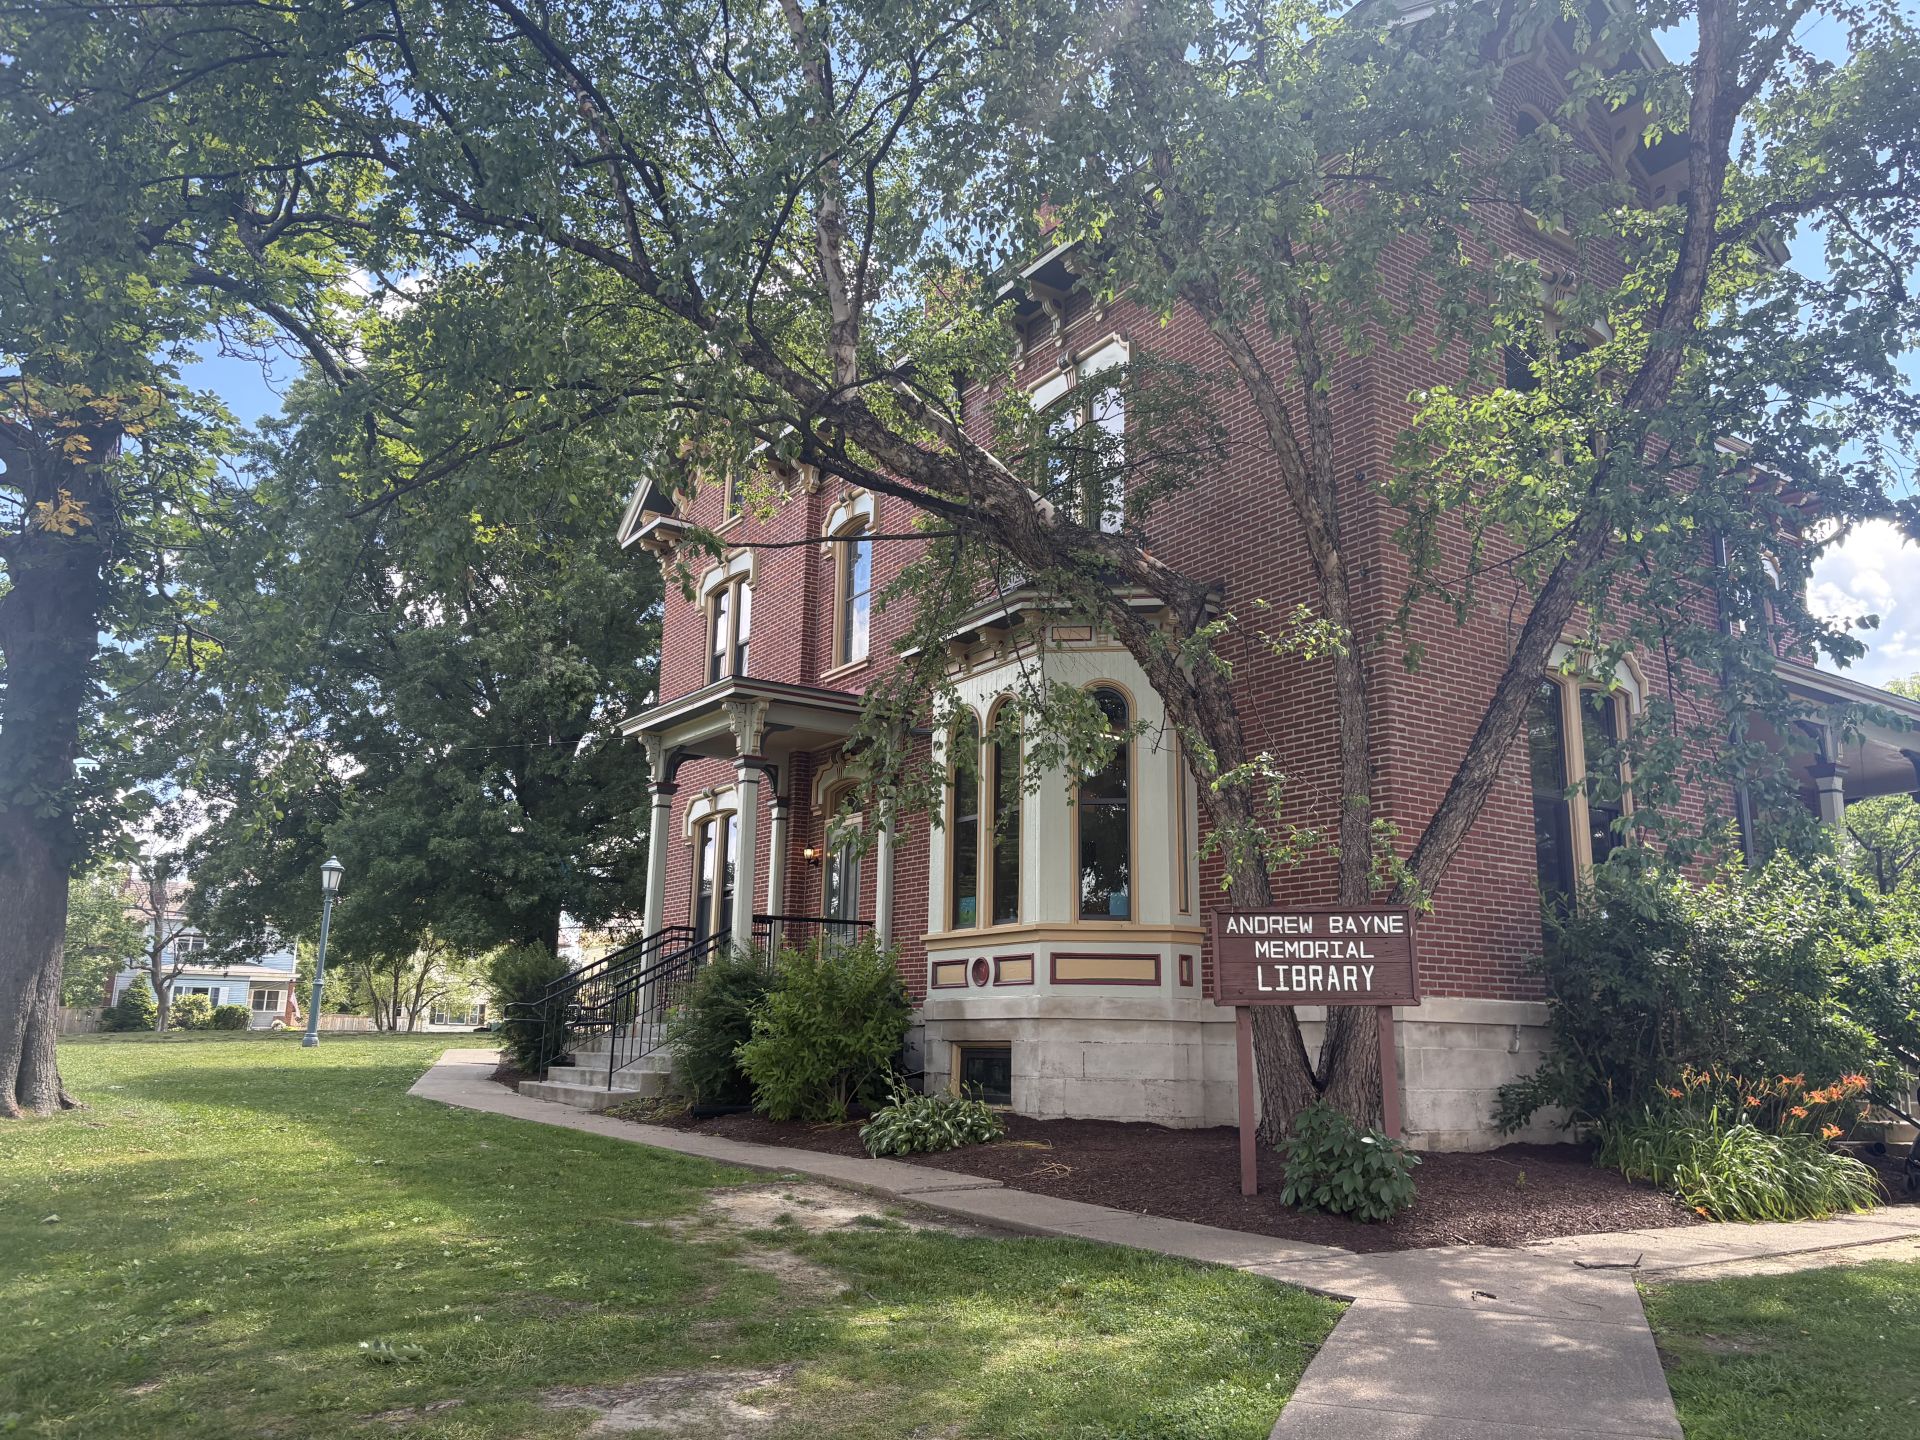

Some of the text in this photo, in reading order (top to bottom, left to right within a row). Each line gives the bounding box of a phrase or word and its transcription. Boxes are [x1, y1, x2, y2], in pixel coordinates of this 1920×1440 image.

[1227, 915, 1403, 934] ANDREW BAYNE
[1255, 941, 1375, 959] MEMORIAL
[1257, 965, 1375, 992] LIBRARY
